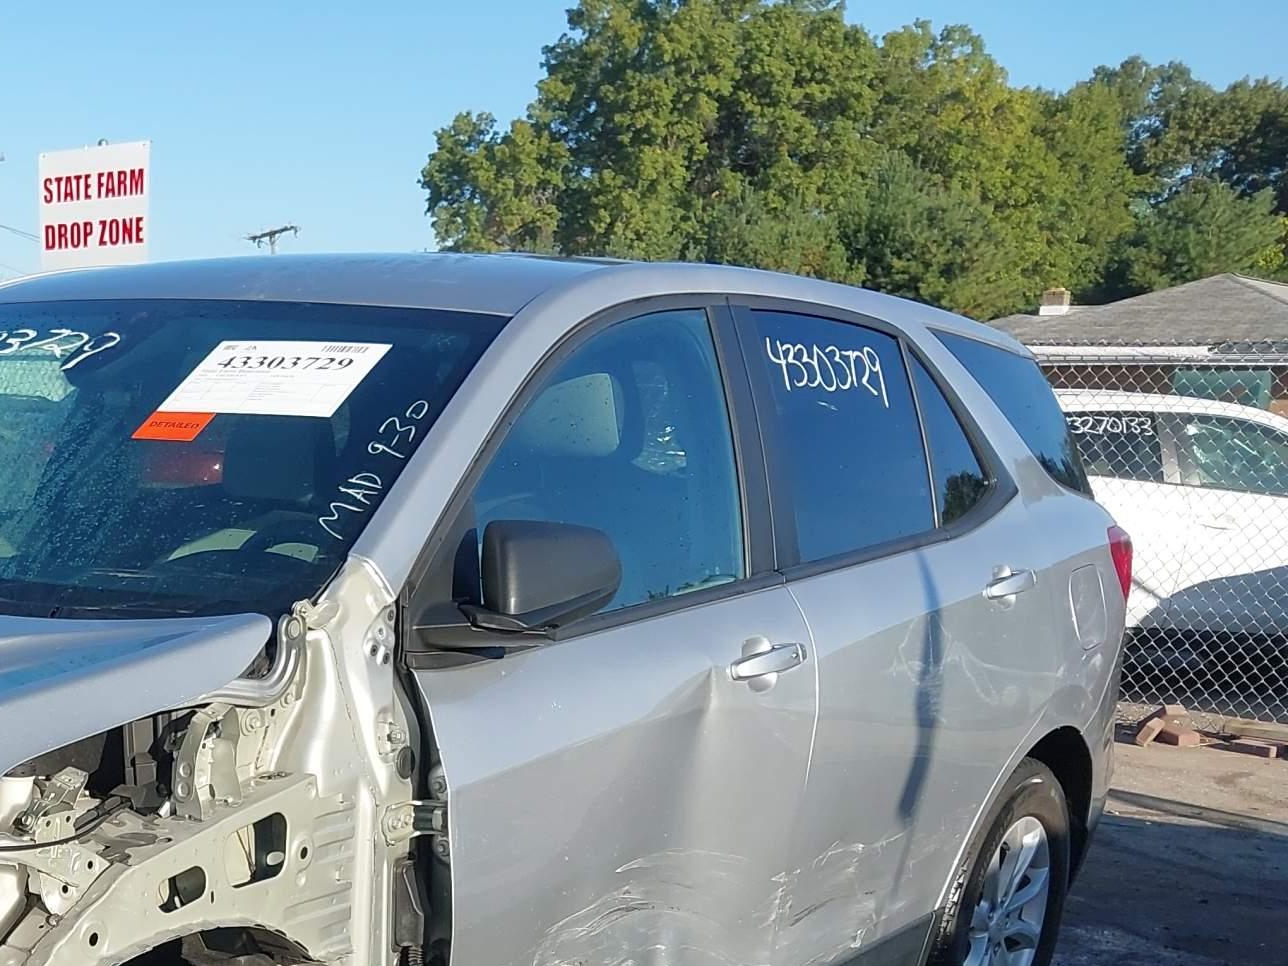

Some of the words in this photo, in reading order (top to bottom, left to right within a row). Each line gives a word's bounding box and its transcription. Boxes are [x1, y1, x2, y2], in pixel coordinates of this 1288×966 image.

[43, 174, 92, 204] STATE
[97, 168, 144, 199] FARM
[44, 221, 93, 251] DROP
[98, 216, 144, 246] ZONE
[217, 355, 354, 371] 43303729
[765, 336, 890, 408] 43303729
[149, 421, 200, 429] DETAILED
[1065, 416, 1153, 436] 3270133
[318, 472, 383, 540] MAD
[367, 399, 429, 458] 9-30
